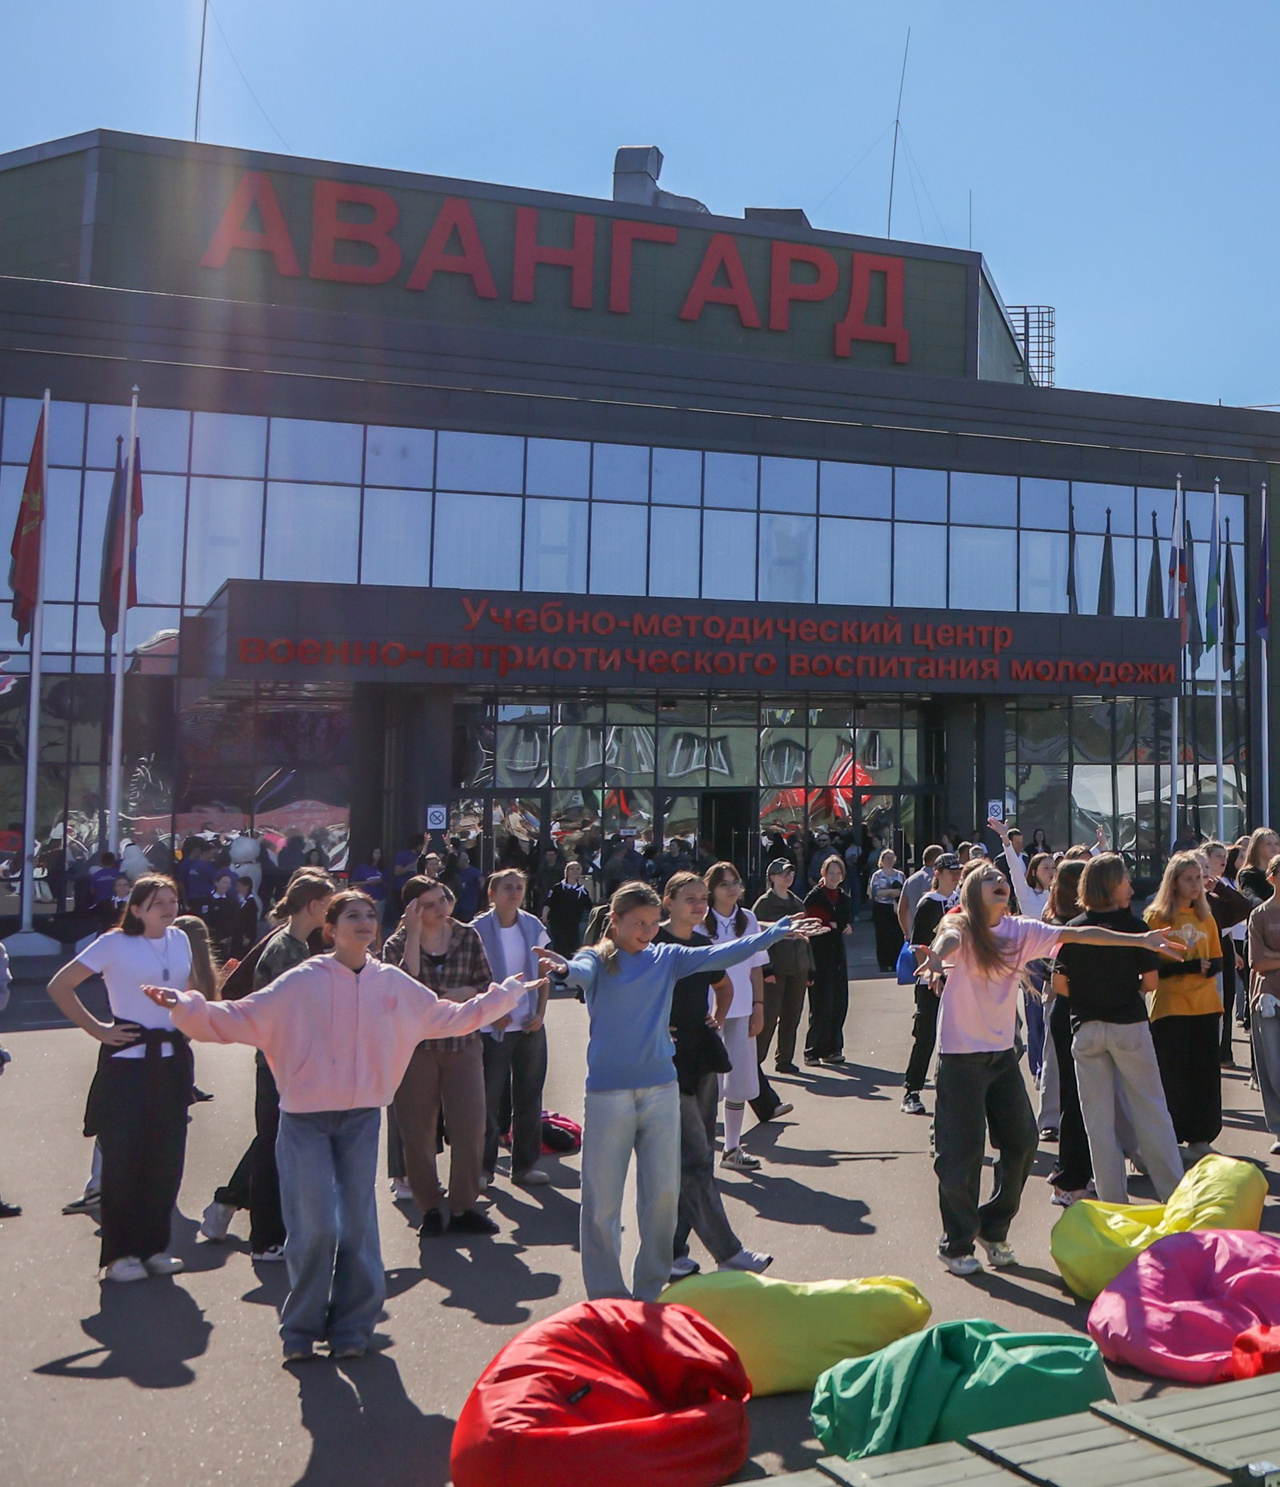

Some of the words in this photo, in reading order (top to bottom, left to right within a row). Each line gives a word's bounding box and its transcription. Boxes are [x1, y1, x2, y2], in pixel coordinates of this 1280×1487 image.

[202, 171, 909, 363] АВАНГАРД
[462, 599, 903, 645] Учебно-методический
[914, 624, 1013, 655] центр
[239, 637, 777, 678] военно-патриотического
[790, 655, 999, 680] воспитания
[1011, 661, 1176, 687] молодежи
